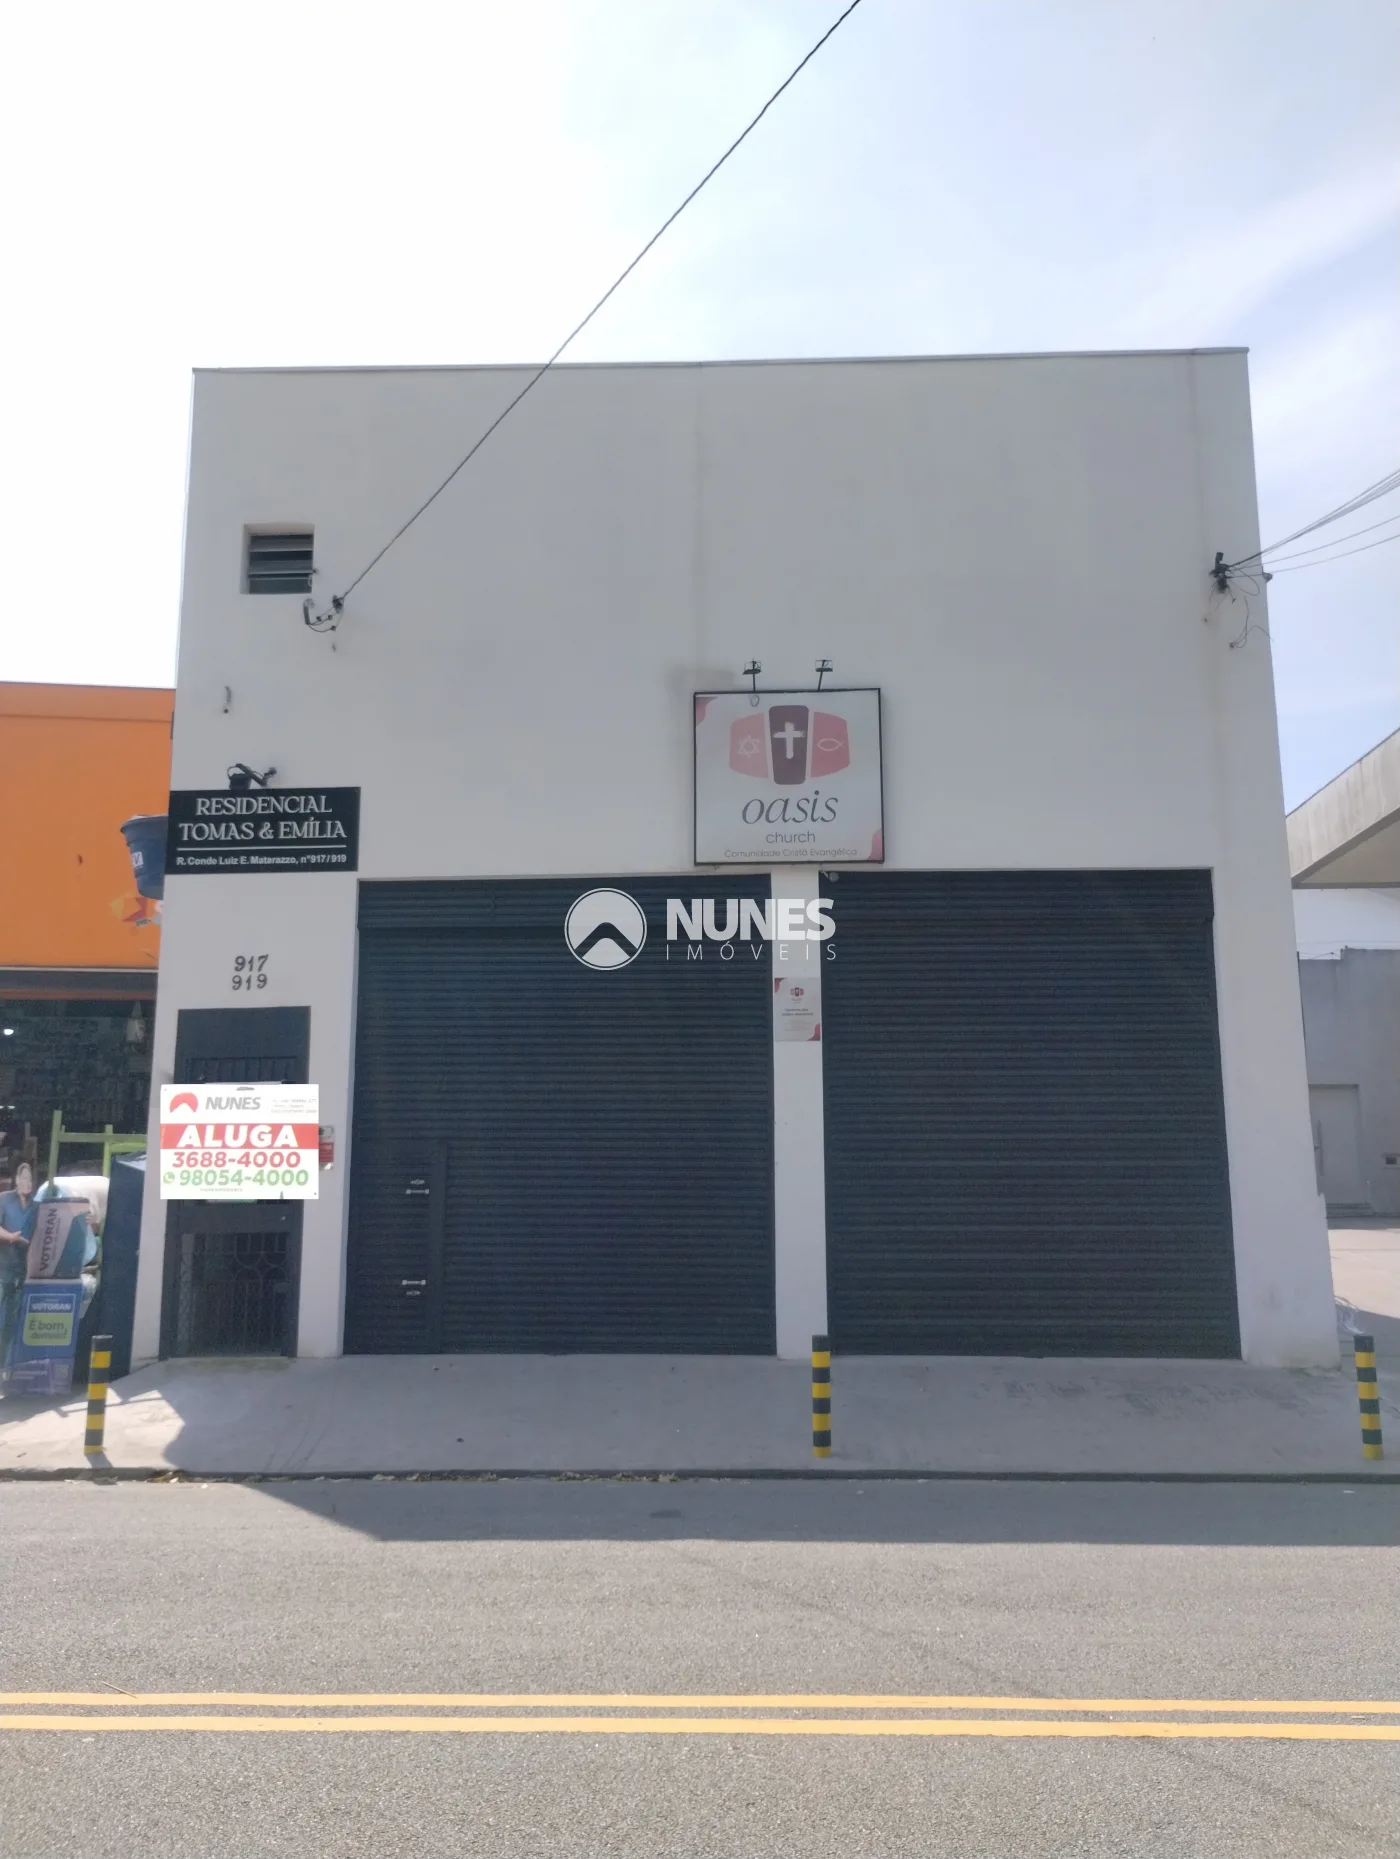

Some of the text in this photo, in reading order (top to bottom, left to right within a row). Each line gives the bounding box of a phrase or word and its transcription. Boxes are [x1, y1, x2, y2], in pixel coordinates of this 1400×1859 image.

[195, 795, 333, 816] RESIDENCIAL
[741, 790, 839, 825] oasis
[178, 816, 348, 841] TOMAS & EMÍLIA
[765, 830, 816, 844] church
[176, 856, 187, 866] R.
[187, 855, 218, 866] Conde
[218, 855, 239, 865] Luiz
[240, 856, 250, 865] E.
[250, 855, 299, 866] Matarazzo,
[724, 849, 781, 858] Comunidade
[810, 847, 858, 858] Evangélica
[234, 954, 269, 973] 917
[231, 973, 268, 991] 919
[205, 1097, 261, 1111] NUNES
[176, 1124, 299, 1148] ALUGA
[172, 1151, 302, 1168] 3688-4000
[179, 1169, 309, 1186] 98054-4000
[39, 1208, 58, 1272] VOTORAN
